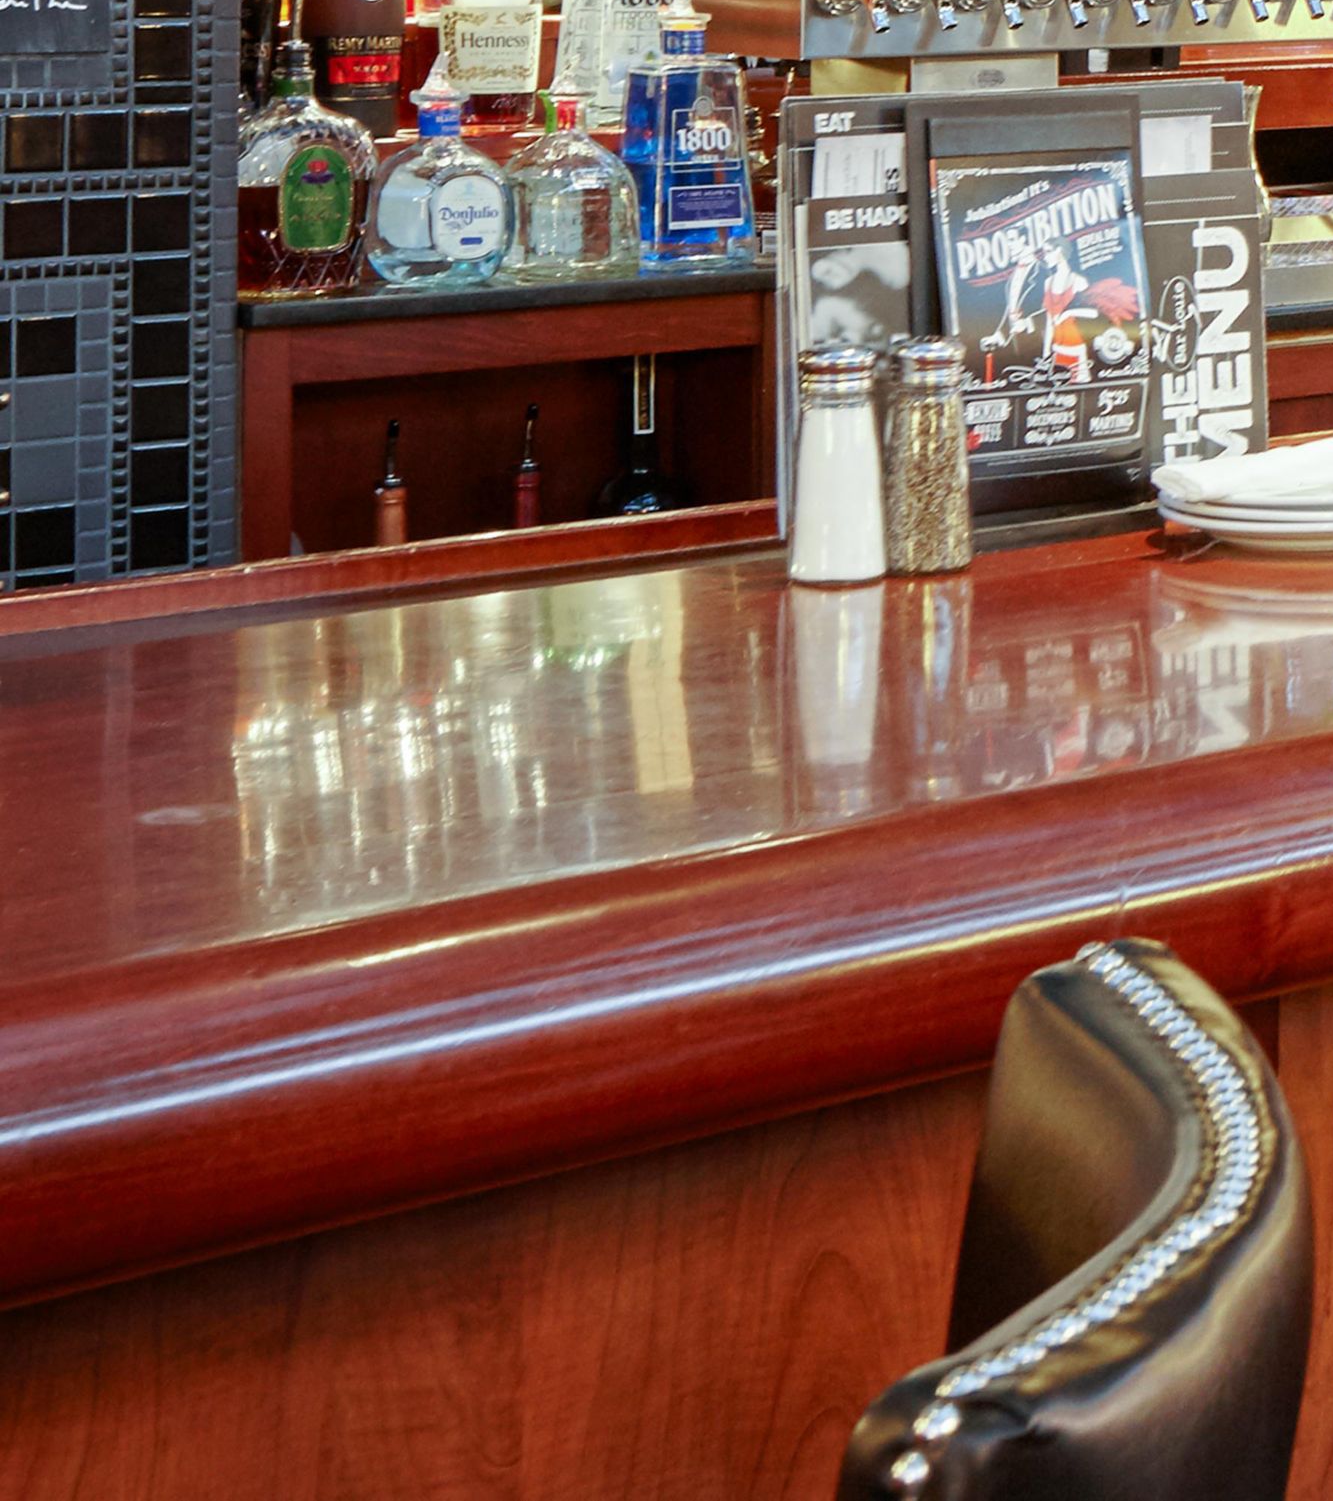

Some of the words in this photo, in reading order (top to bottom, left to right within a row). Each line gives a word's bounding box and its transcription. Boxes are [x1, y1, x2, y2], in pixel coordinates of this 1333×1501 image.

[813, 111, 856, 134] EAT
[676, 127, 732, 152] 1800
[825, 208, 855, 231] BE
[955, 182, 1119, 280] PROIBITION
[1161, 370, 1203, 466] THE
[1191, 225, 1253, 461] MENU
